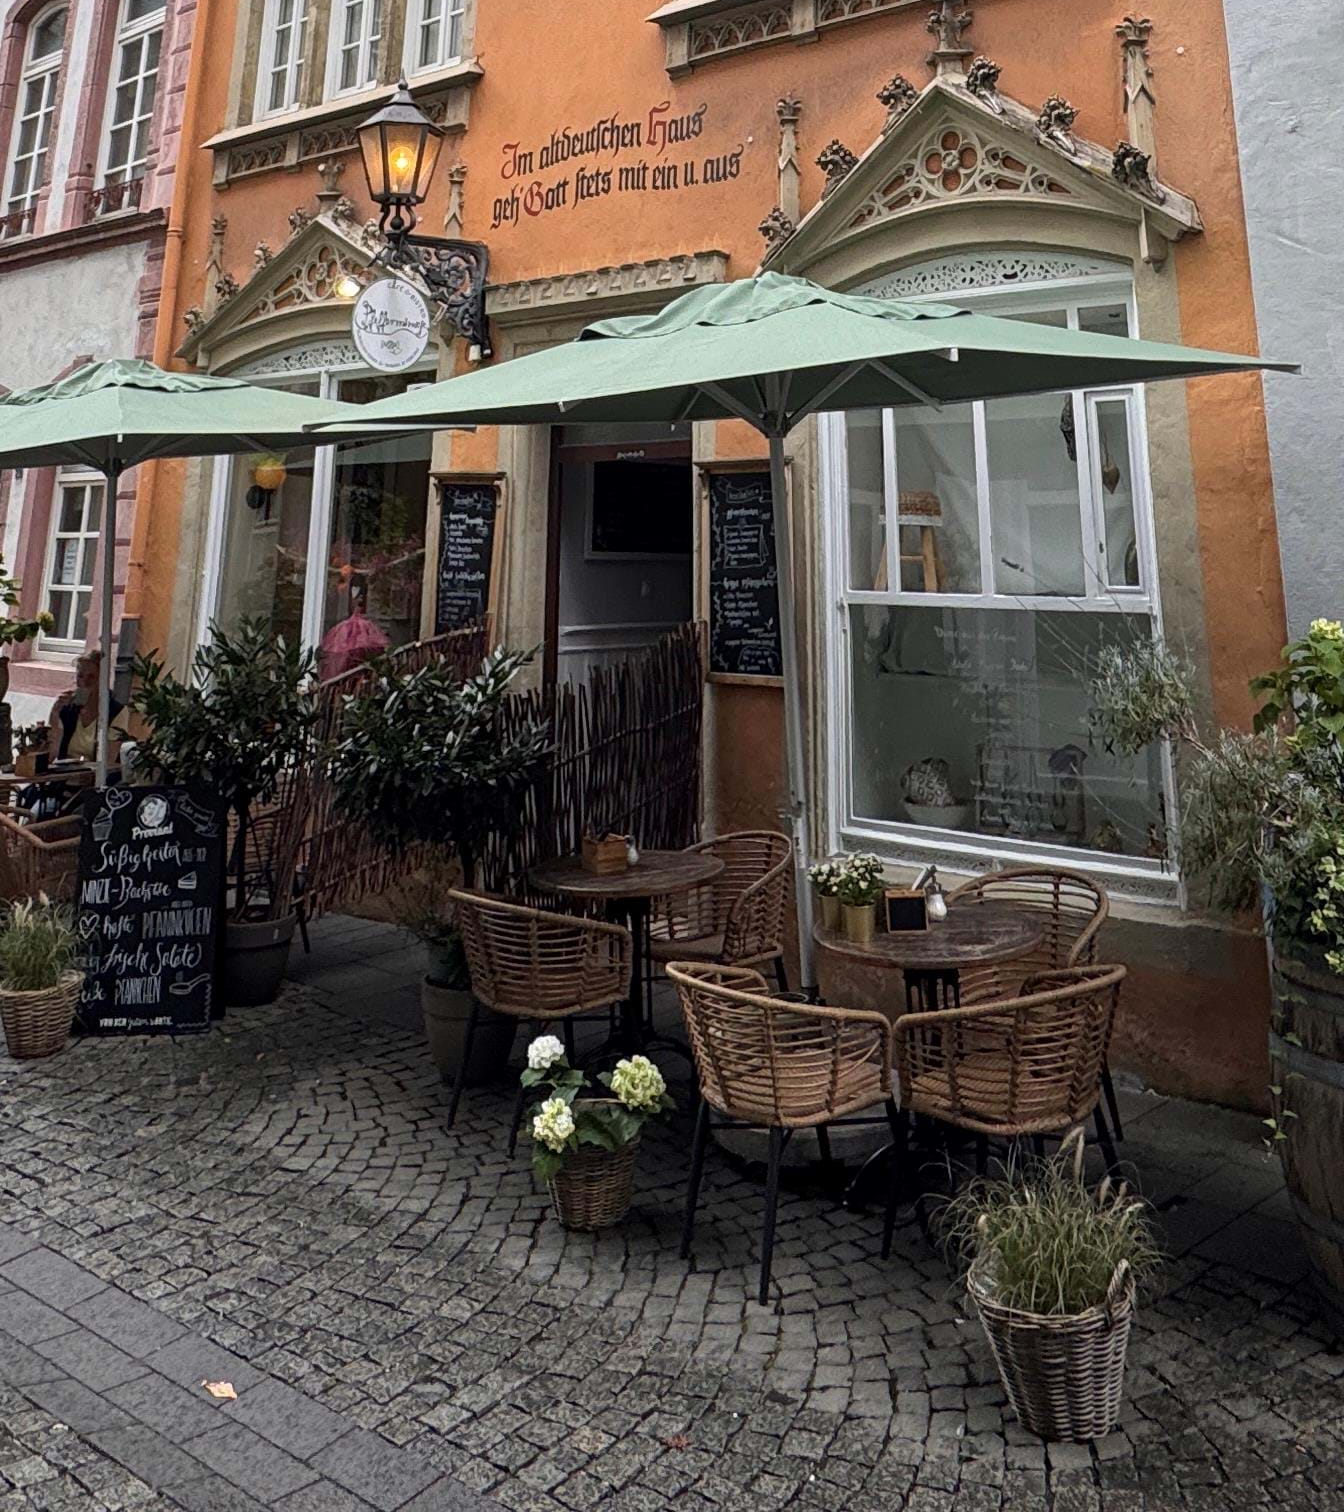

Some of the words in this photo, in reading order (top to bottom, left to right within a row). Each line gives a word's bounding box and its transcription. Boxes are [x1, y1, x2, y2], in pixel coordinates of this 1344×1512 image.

[501, 141, 533, 179] Im
[645, 101, 707, 156] Haus
[523, 180, 569, 216] Gott
[618, 158, 649, 191] mit
[652, 157, 678, 191] ein
[684, 161, 699, 186] u.
[703, 144, 744, 185] aus
